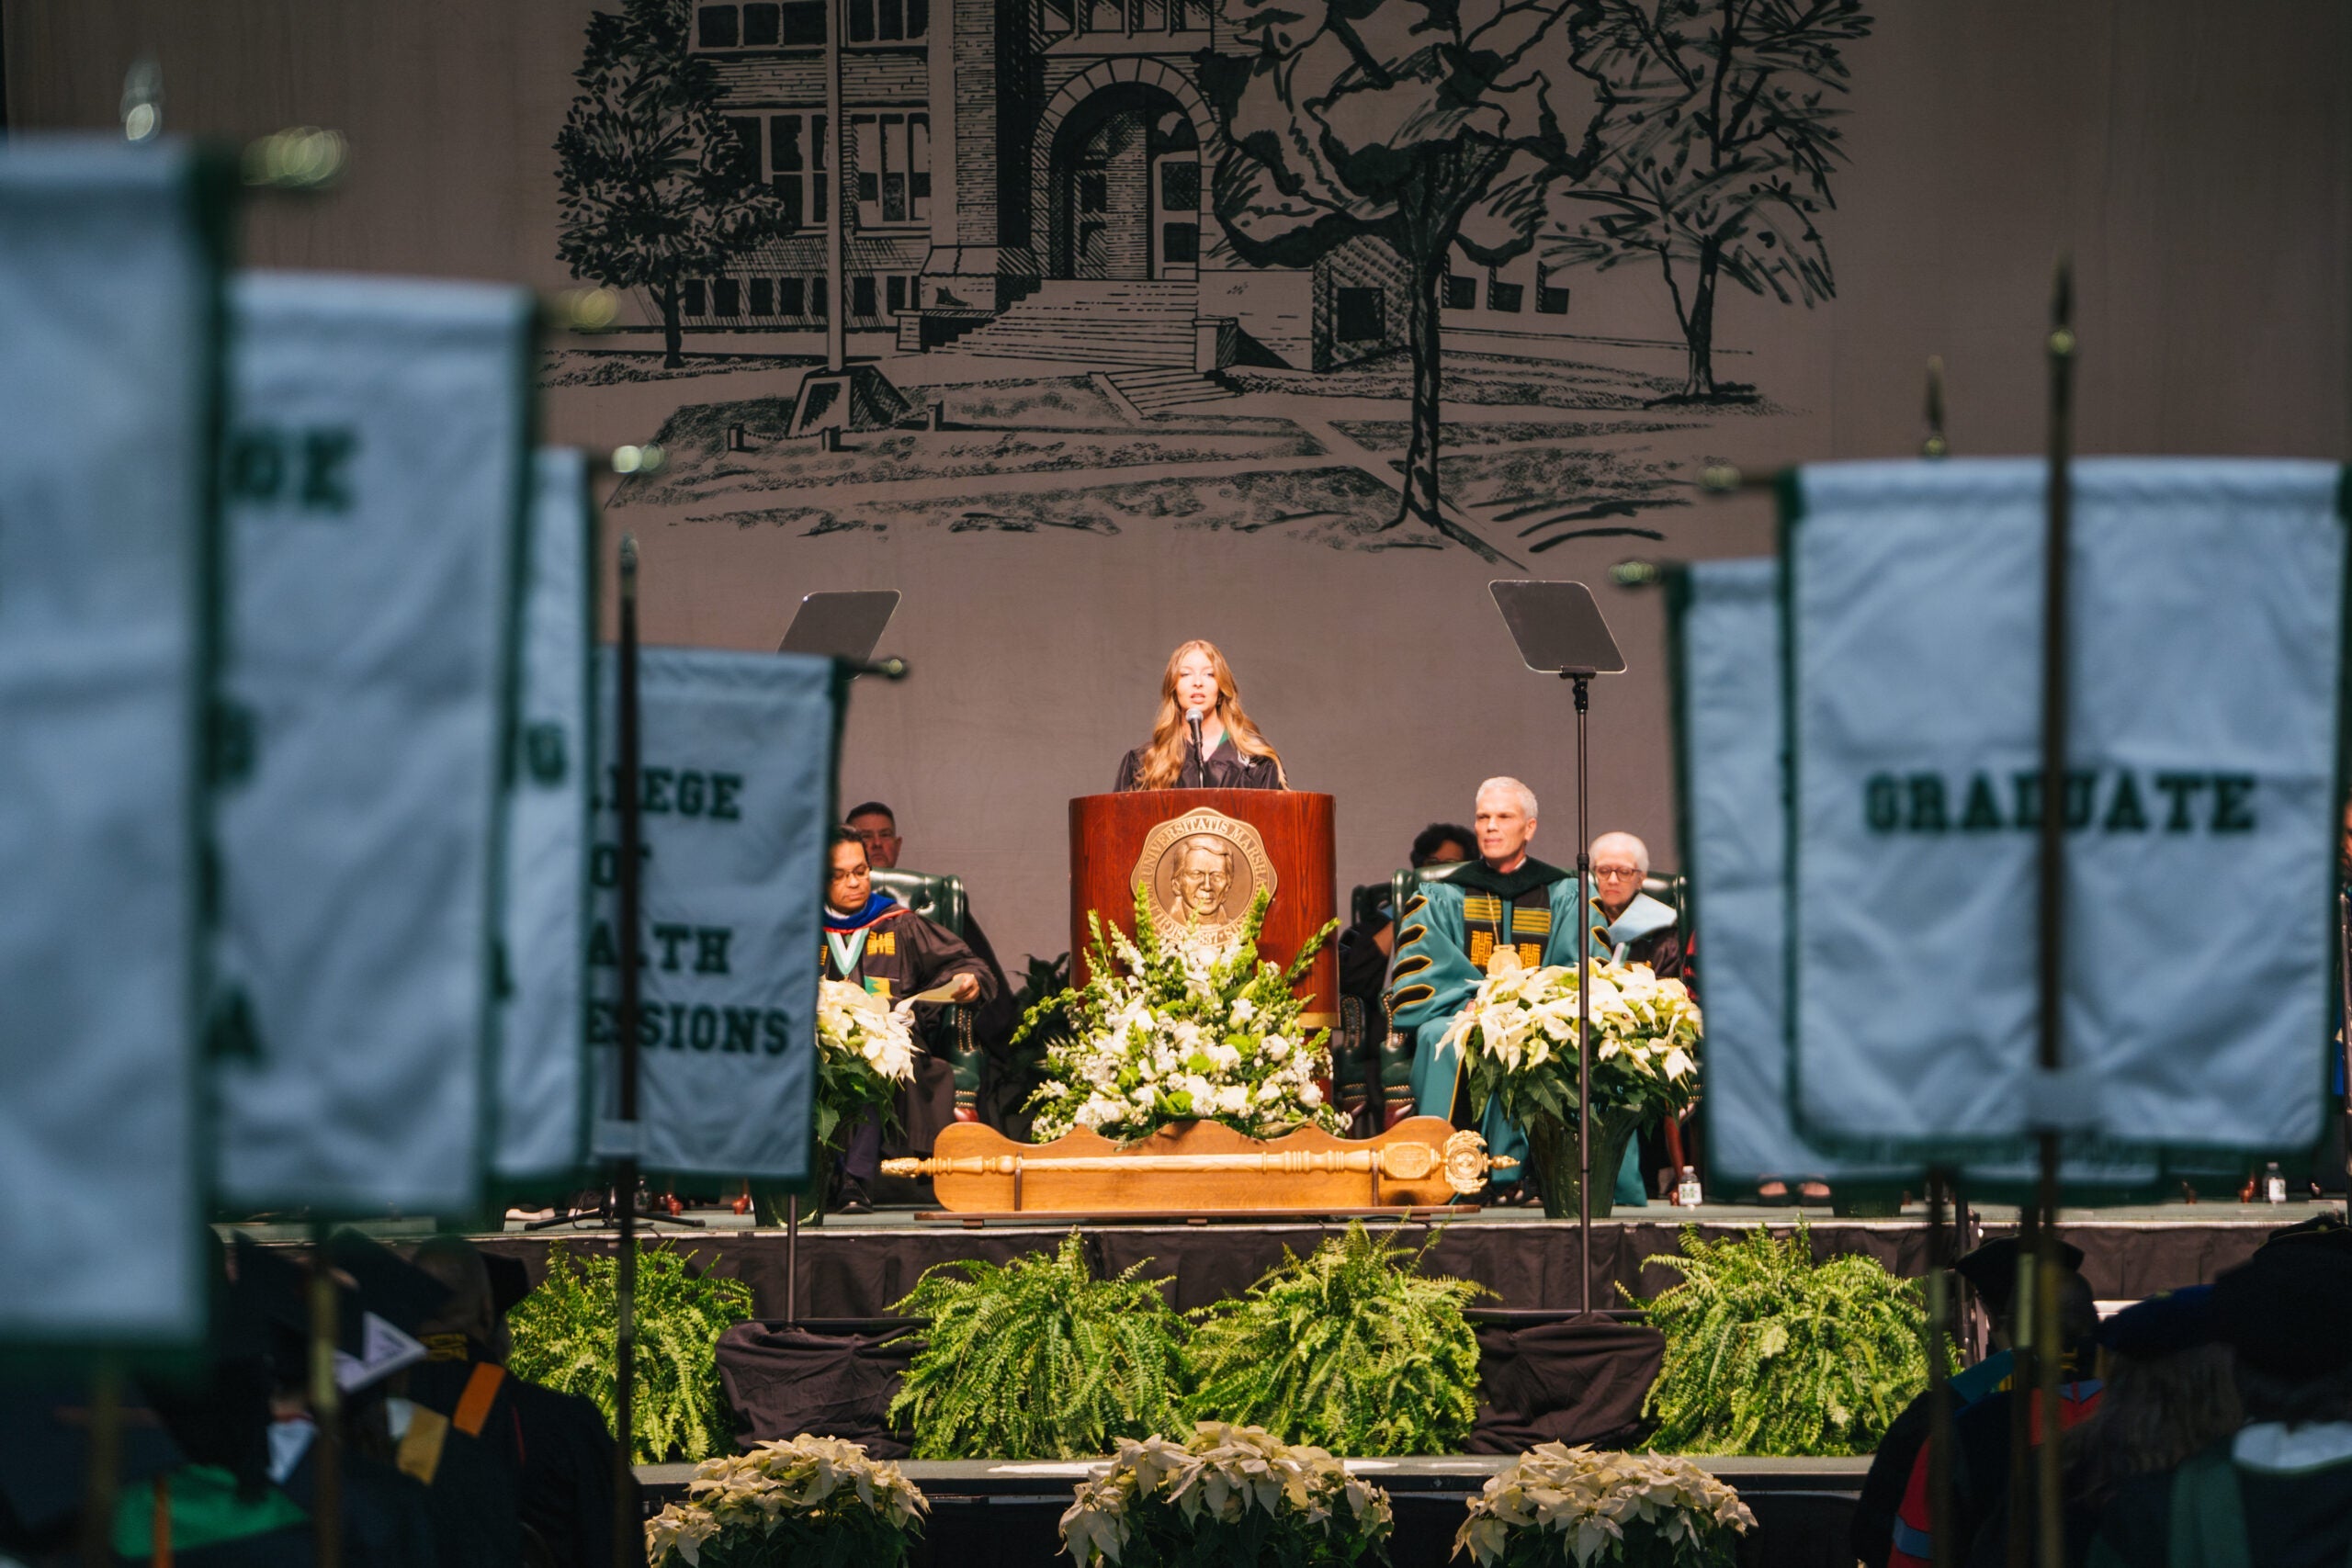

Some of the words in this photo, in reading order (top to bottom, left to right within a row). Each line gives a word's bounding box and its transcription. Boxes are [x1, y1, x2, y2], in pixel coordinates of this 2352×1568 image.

[1862, 768, 2257, 834] GRADUATE
[590, 842, 652, 889] O
[1142, 818, 1228, 875] UNIVERSITATIS
